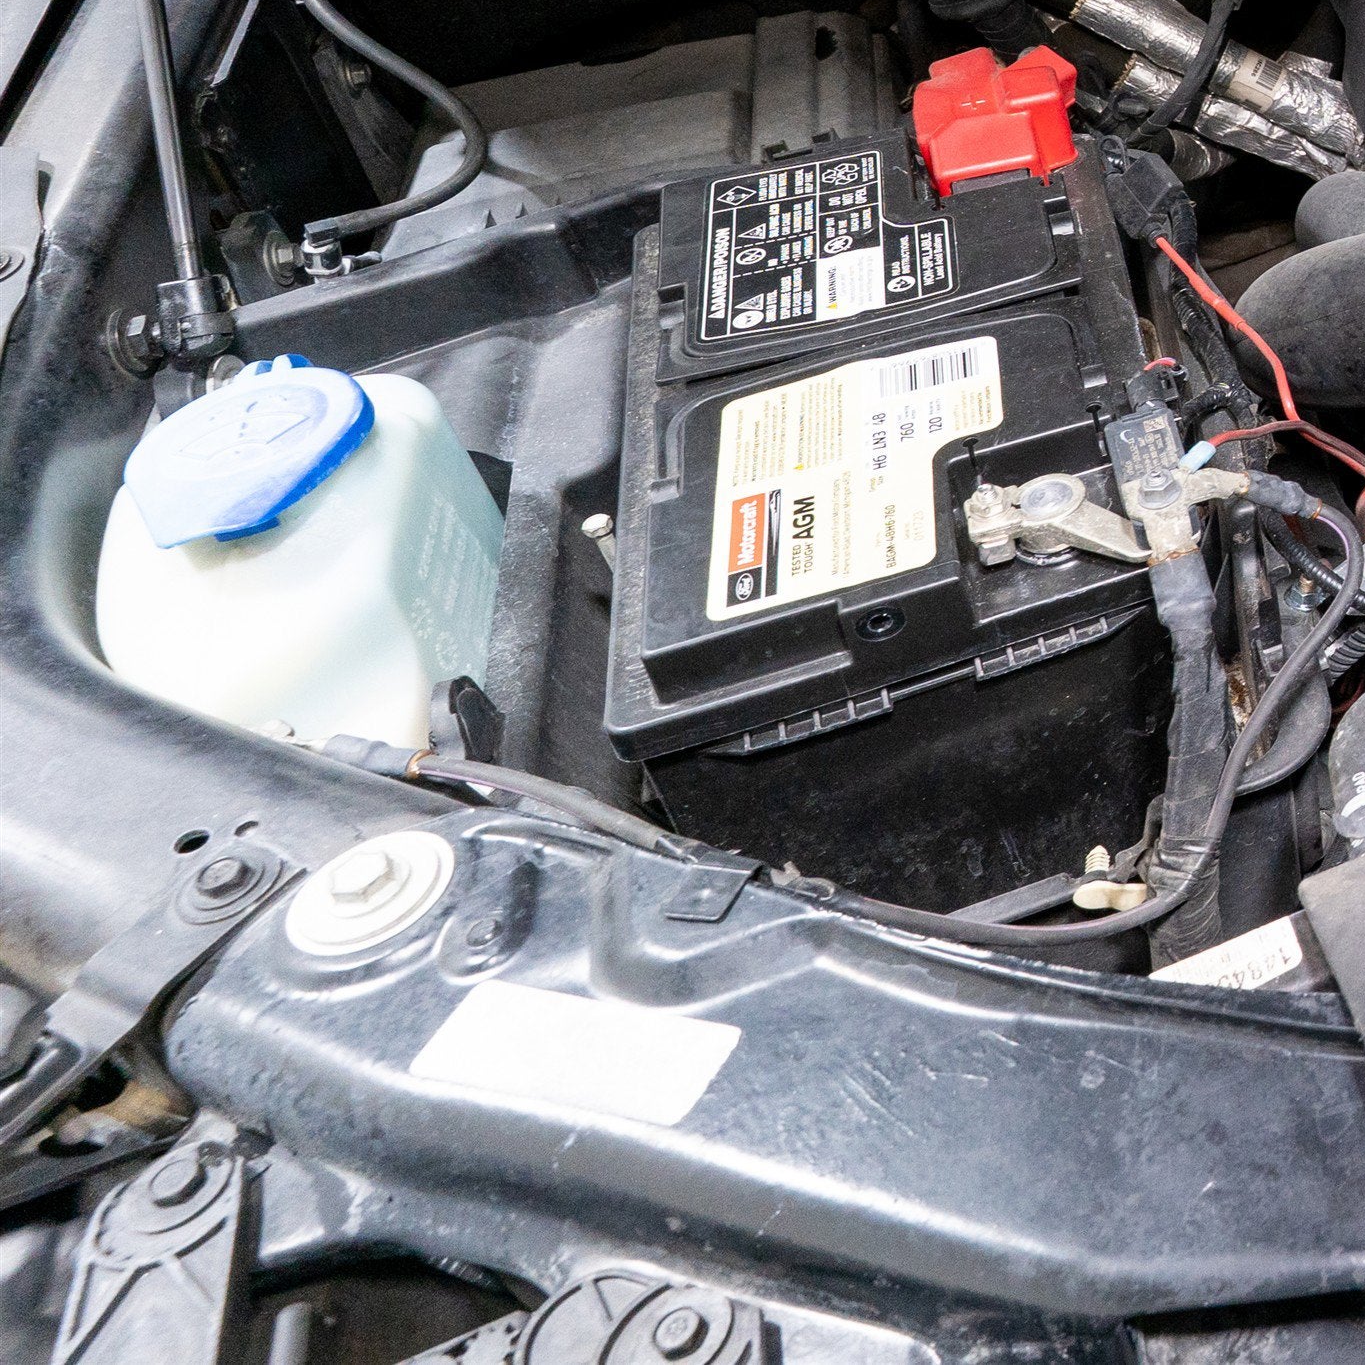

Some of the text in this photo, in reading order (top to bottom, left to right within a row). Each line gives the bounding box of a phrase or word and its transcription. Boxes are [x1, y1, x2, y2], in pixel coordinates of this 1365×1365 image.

[829, 196, 840, 206] DO
[842, 192, 854, 205] NOT
[711, 227, 730, 312] DANGER/POISON
[920, 232, 935, 286] NON-SPILLABLE
[933, 232, 945, 279] Lead Acid Battery
[828, 266, 837, 303] WARNING:
[871, 411, 886, 470] H6 LN3 48
[899, 420, 914, 442] 760
[927, 415, 942, 433] 120
[736, 499, 757, 565] Motorcraft
[791, 494, 815, 543] AGM
[791, 543, 801, 576] TESTED
[803, 542, 813, 572] TOUGH
